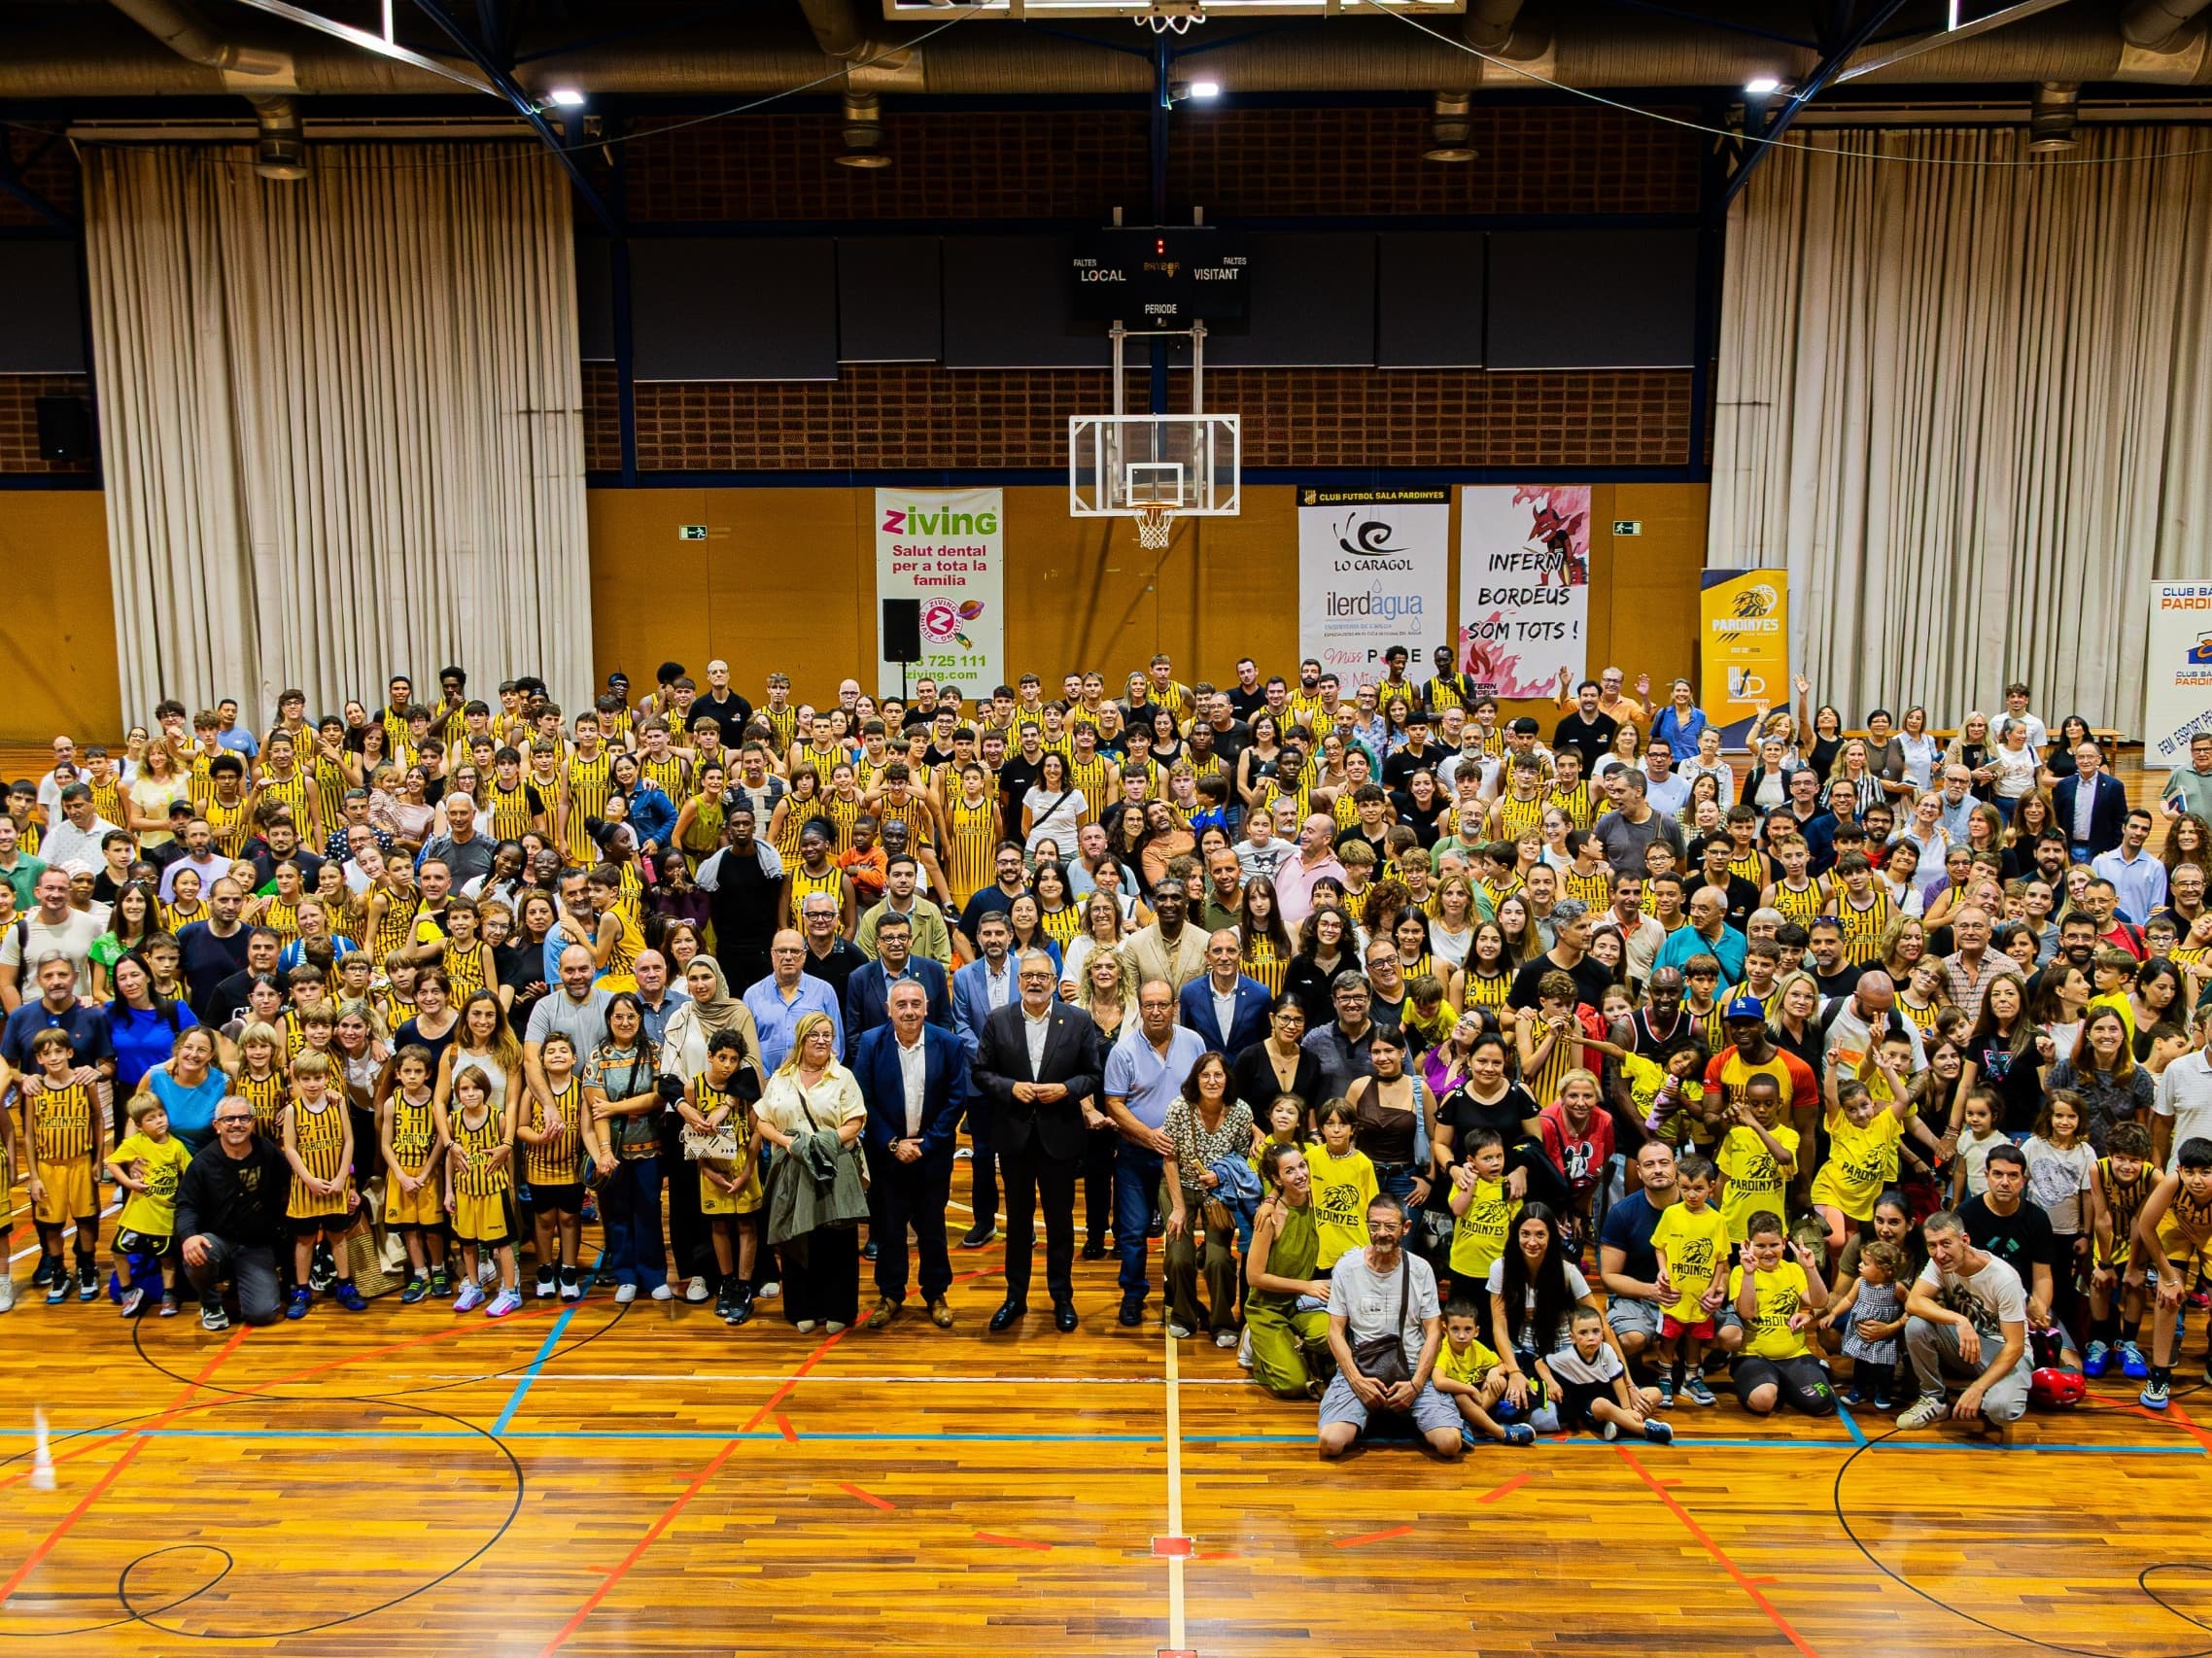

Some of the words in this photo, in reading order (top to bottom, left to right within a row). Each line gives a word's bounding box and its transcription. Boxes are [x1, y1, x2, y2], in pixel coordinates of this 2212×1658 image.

[1073, 259, 1096, 267] FALTES
[1223, 257, 1247, 265] FALTES
[1081, 269, 1126, 282] LOCAL
[1193, 268, 1239, 281] VISITANT
[1145, 304, 1177, 314] PERIODE
[1319, 493, 1341, 501] CLUB
[1399, 491, 1444, 500] PARDINYES
[892, 544, 933, 557] Salut
[937, 544, 986, 557] dental
[892, 561, 918, 574] per
[922, 561, 932, 571] a
[937, 560, 968, 571] tota
[973, 560, 986, 571] la
[1334, 561, 1351, 571] LO
[1354, 559, 1413, 571] CARAGOL
[1489, 553, 1563, 573] INFERN
[1478, 588, 1571, 608] BORDEUS
[2162, 587, 2195, 597] CLUB
[1327, 591, 1423, 621] ilerdagua
[1468, 622, 1510, 640] SOM
[1516, 622, 1566, 642] TOTS
[1711, 619, 1780, 632] PARDINYES
[928, 655, 955, 667] 725
[960, 655, 985, 667] 111
[906, 670, 978, 682] ziving.com
[2158, 736, 2177, 757] FEM
[2173, 717, 2205, 746] ESPORT
[1568, 883, 1581, 896] 24
[297, 1124, 311, 1136] 27
